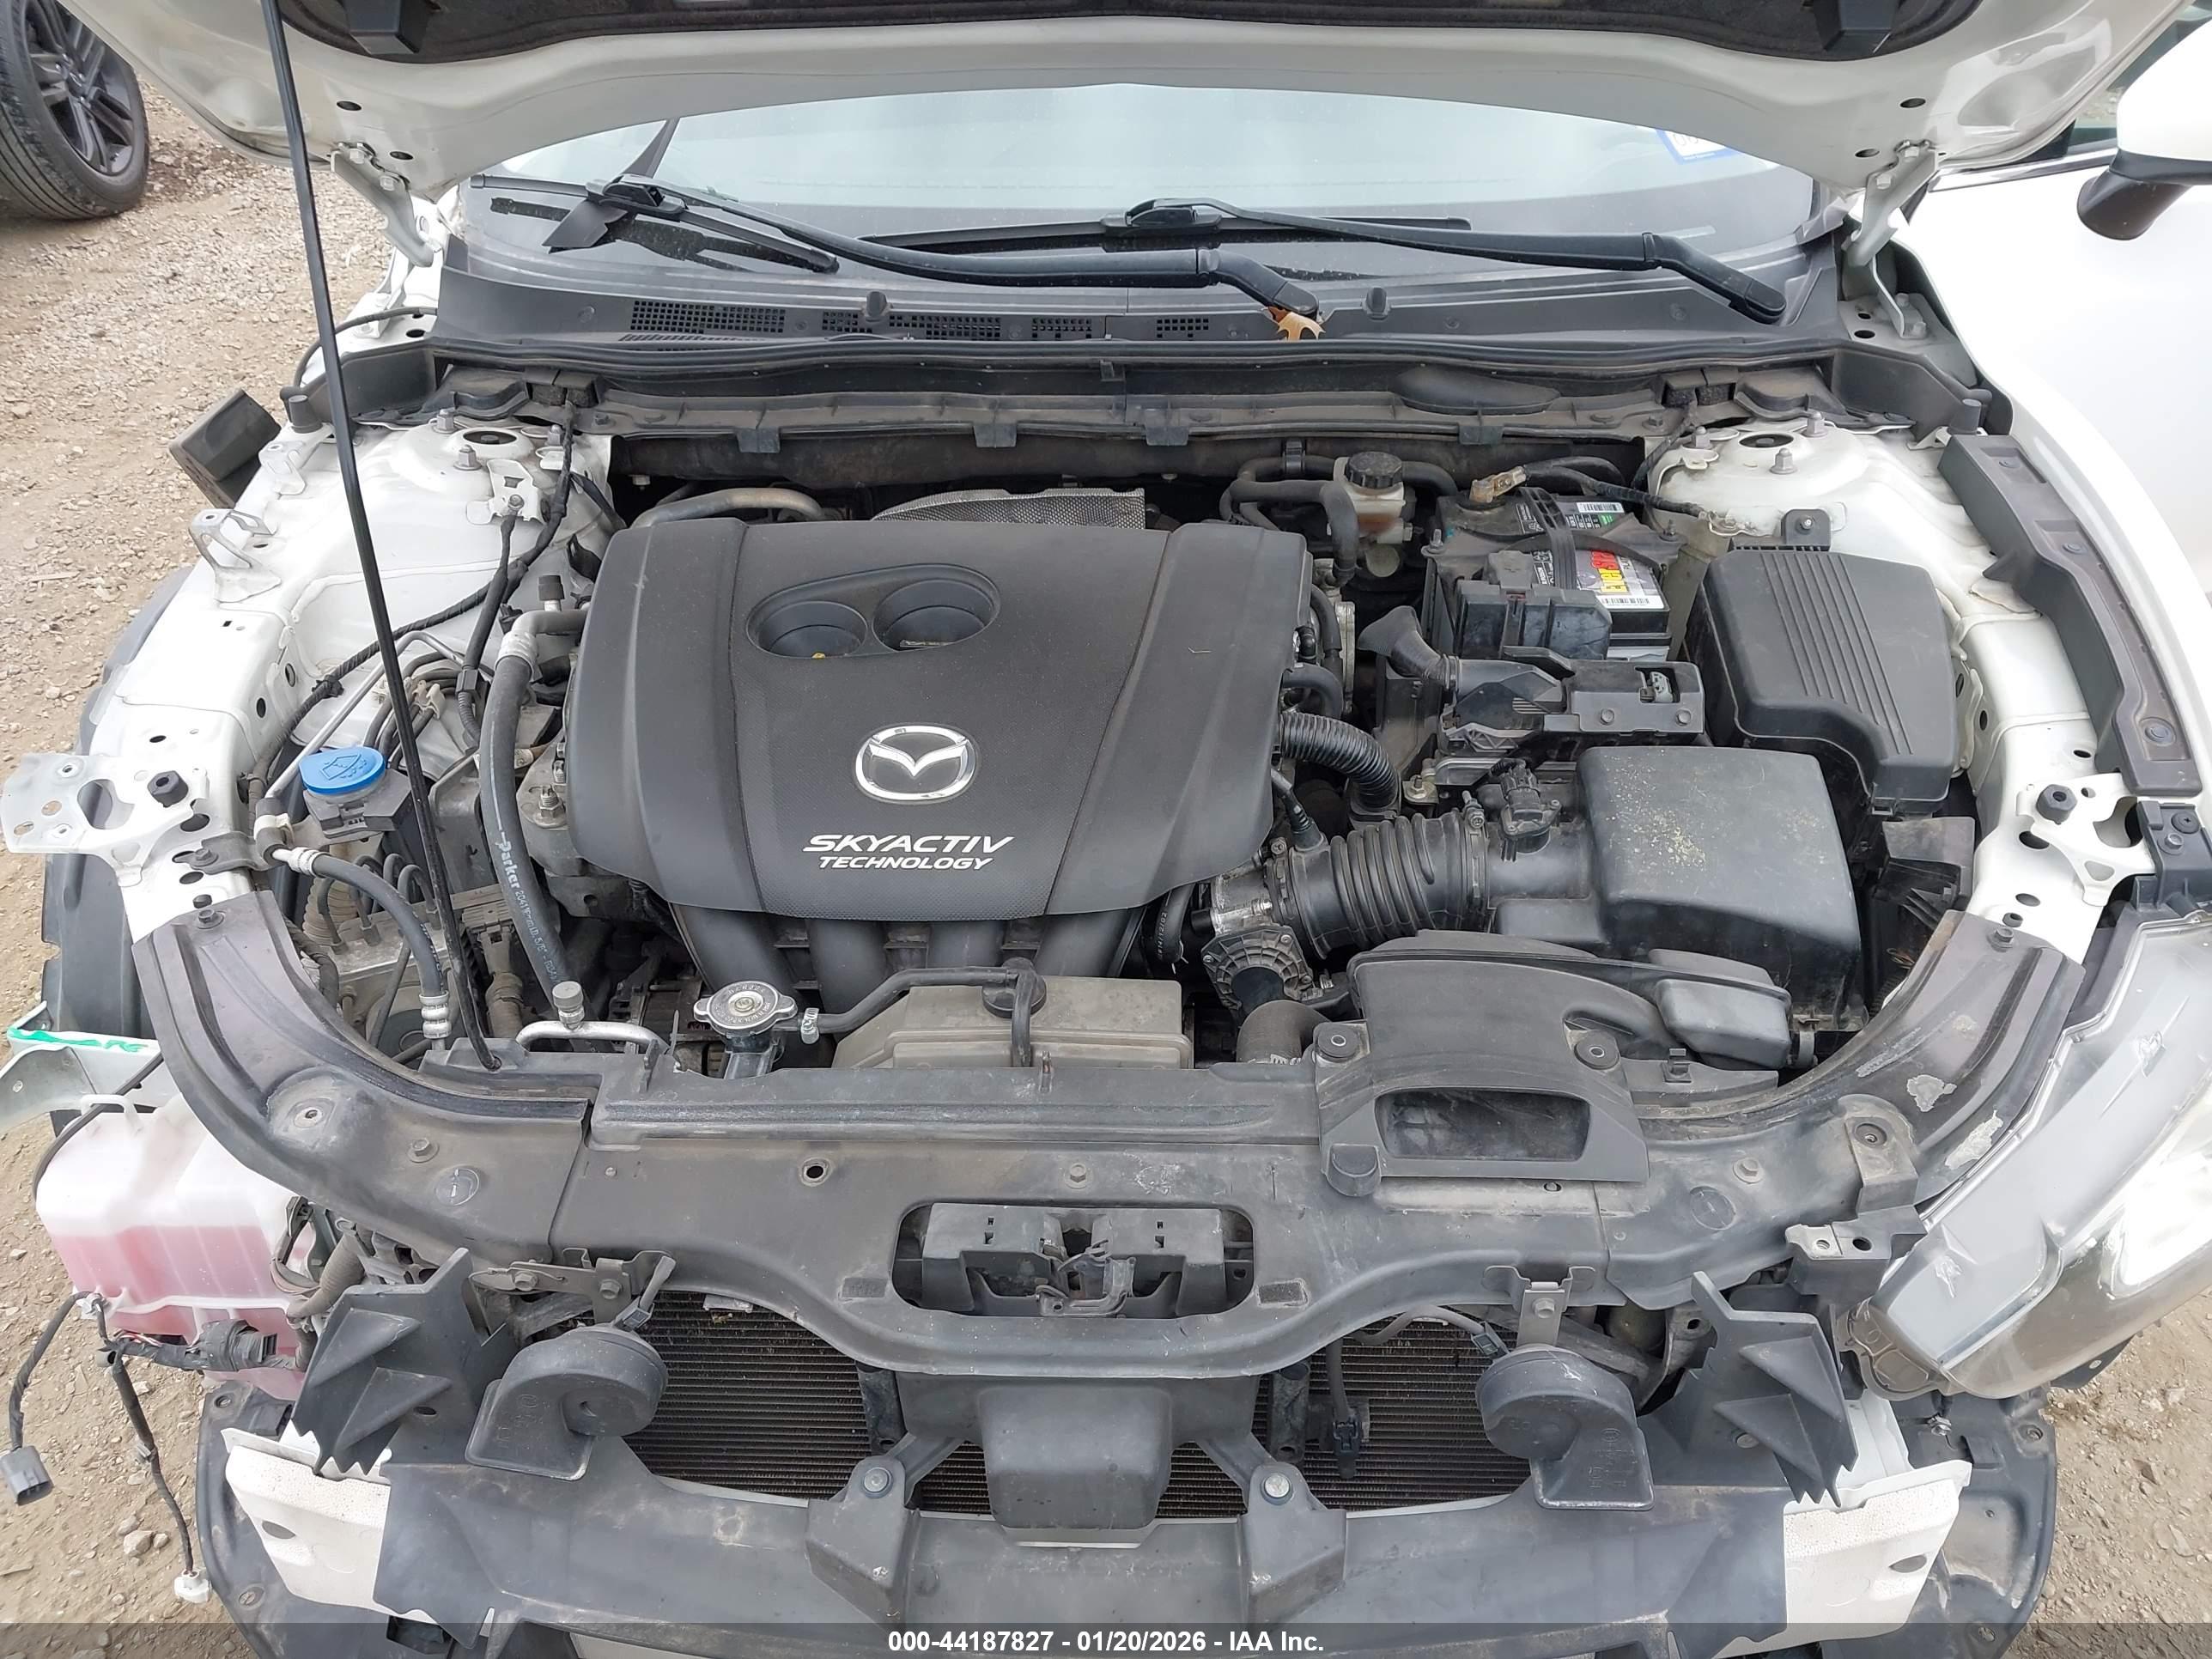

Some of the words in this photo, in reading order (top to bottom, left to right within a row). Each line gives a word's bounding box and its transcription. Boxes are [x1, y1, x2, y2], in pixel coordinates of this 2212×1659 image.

[802, 834, 1015, 854] SKYACTIV
[495, 841, 520, 889] Parker
[819, 856, 994, 870] TECHNOLOGY
